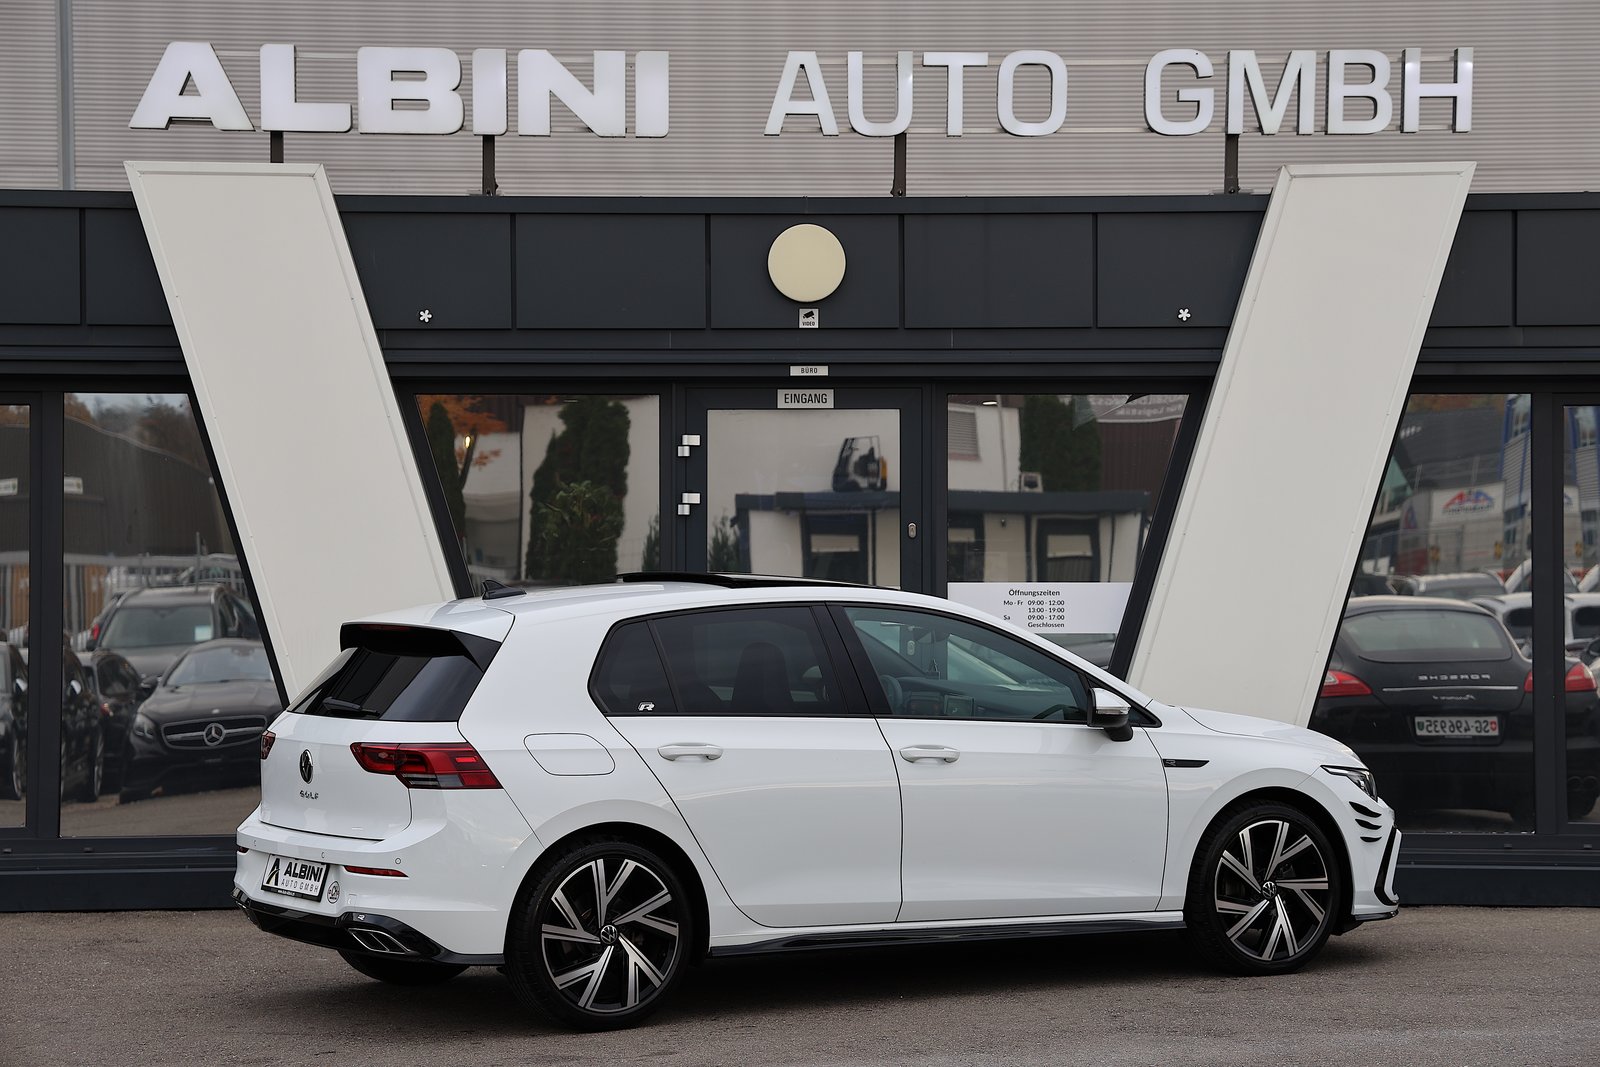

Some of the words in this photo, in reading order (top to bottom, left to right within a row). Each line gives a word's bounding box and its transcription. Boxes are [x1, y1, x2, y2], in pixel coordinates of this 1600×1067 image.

[128, 41, 670, 138] ALBINI
[764, 48, 1068, 138] AUTO
[1143, 46, 1475, 136] GMBH
[784, 393, 828, 404] EINGANG
[1008, 589, 1061, 597] Öffnungszeiten
[284, 862, 323, 882] ALBINI
[281, 879, 298, 889] AUTO
[300, 882, 319, 893] GMBH
